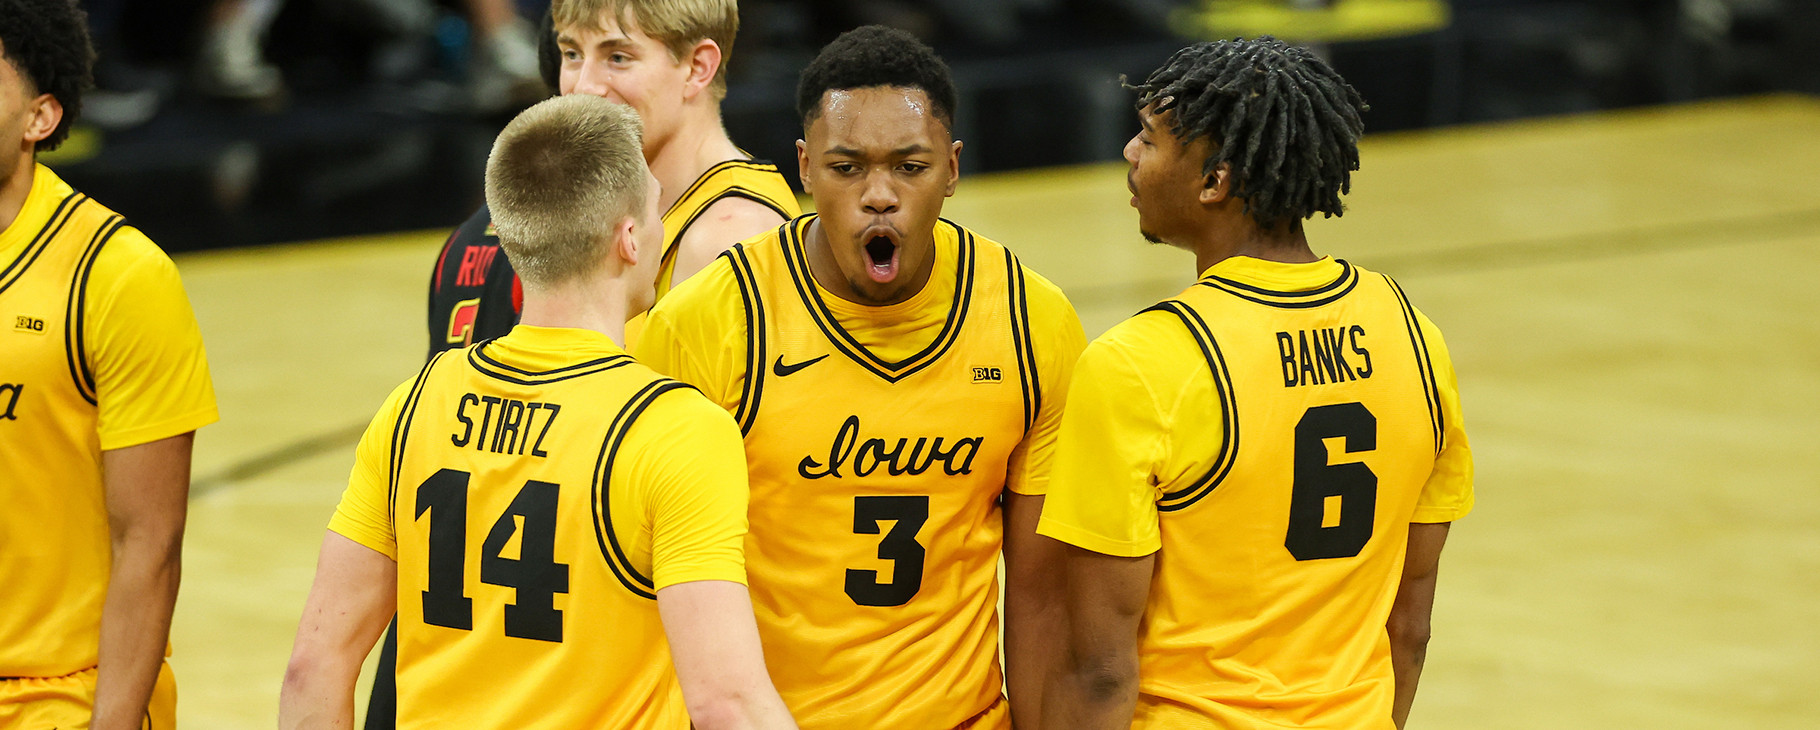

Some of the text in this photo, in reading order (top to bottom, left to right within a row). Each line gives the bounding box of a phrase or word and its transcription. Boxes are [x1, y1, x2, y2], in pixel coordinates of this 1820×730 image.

[1276, 325, 1373, 388] BANKS
[451, 392, 562, 458] STIRTZ
[798, 415, 984, 479] Iowa
[1284, 401, 1378, 561] 6
[415, 468, 569, 643] 14
[844, 496, 929, 607] 3
